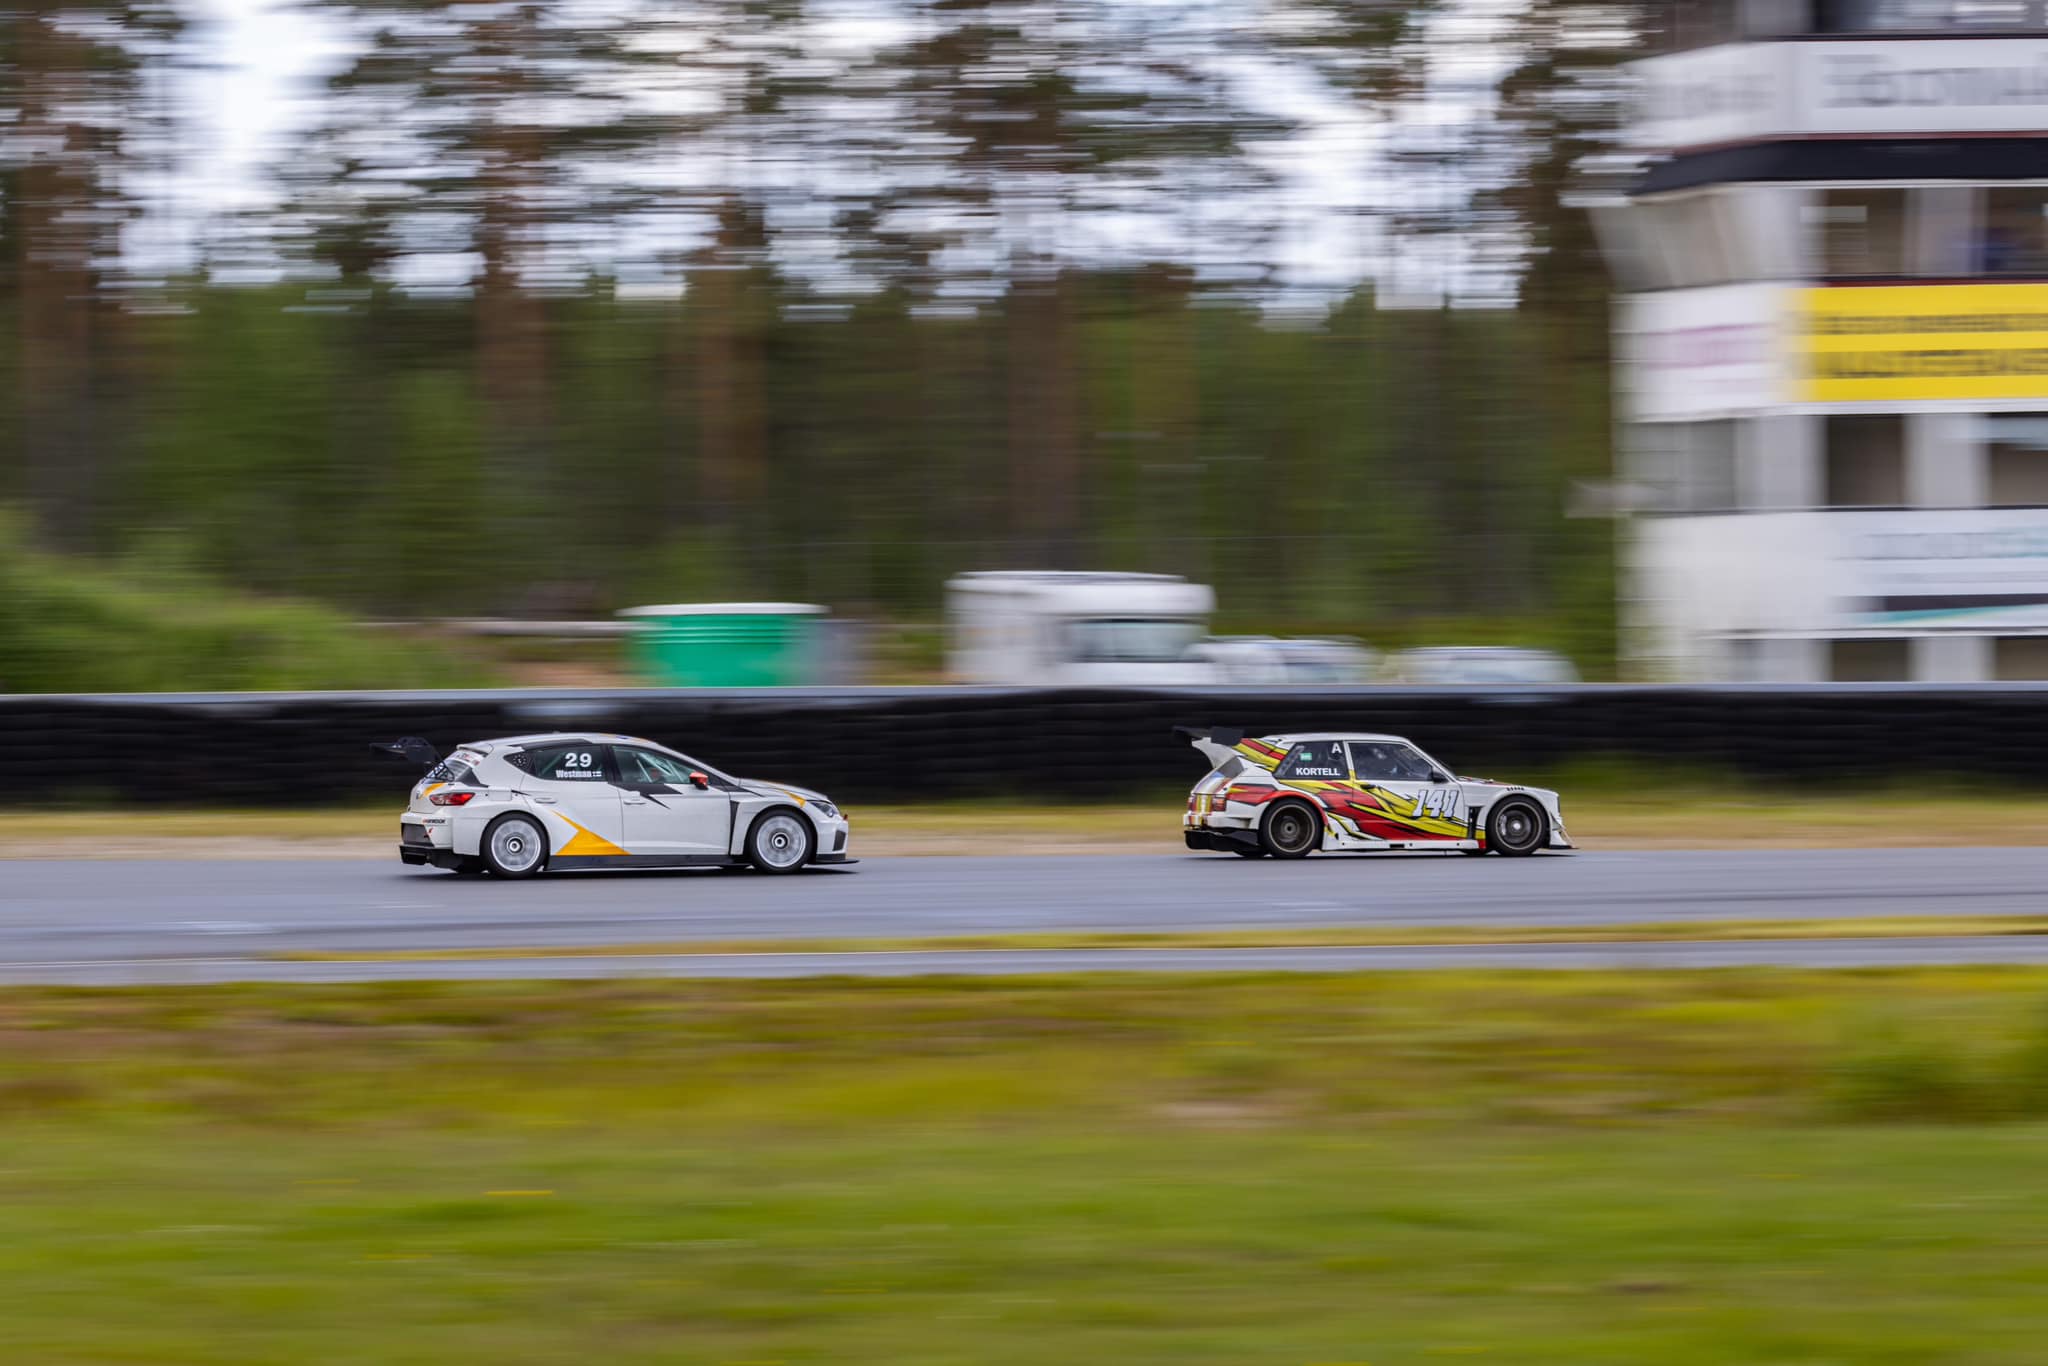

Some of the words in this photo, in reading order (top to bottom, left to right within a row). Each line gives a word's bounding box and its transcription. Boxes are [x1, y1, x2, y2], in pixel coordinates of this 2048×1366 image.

[1331, 742, 1342, 754] A
[565, 752, 592, 768] 29
[555, 769, 592, 778] Westman
[1296, 767, 1341, 776] KORTELL
[1412, 789, 1459, 819] 141
